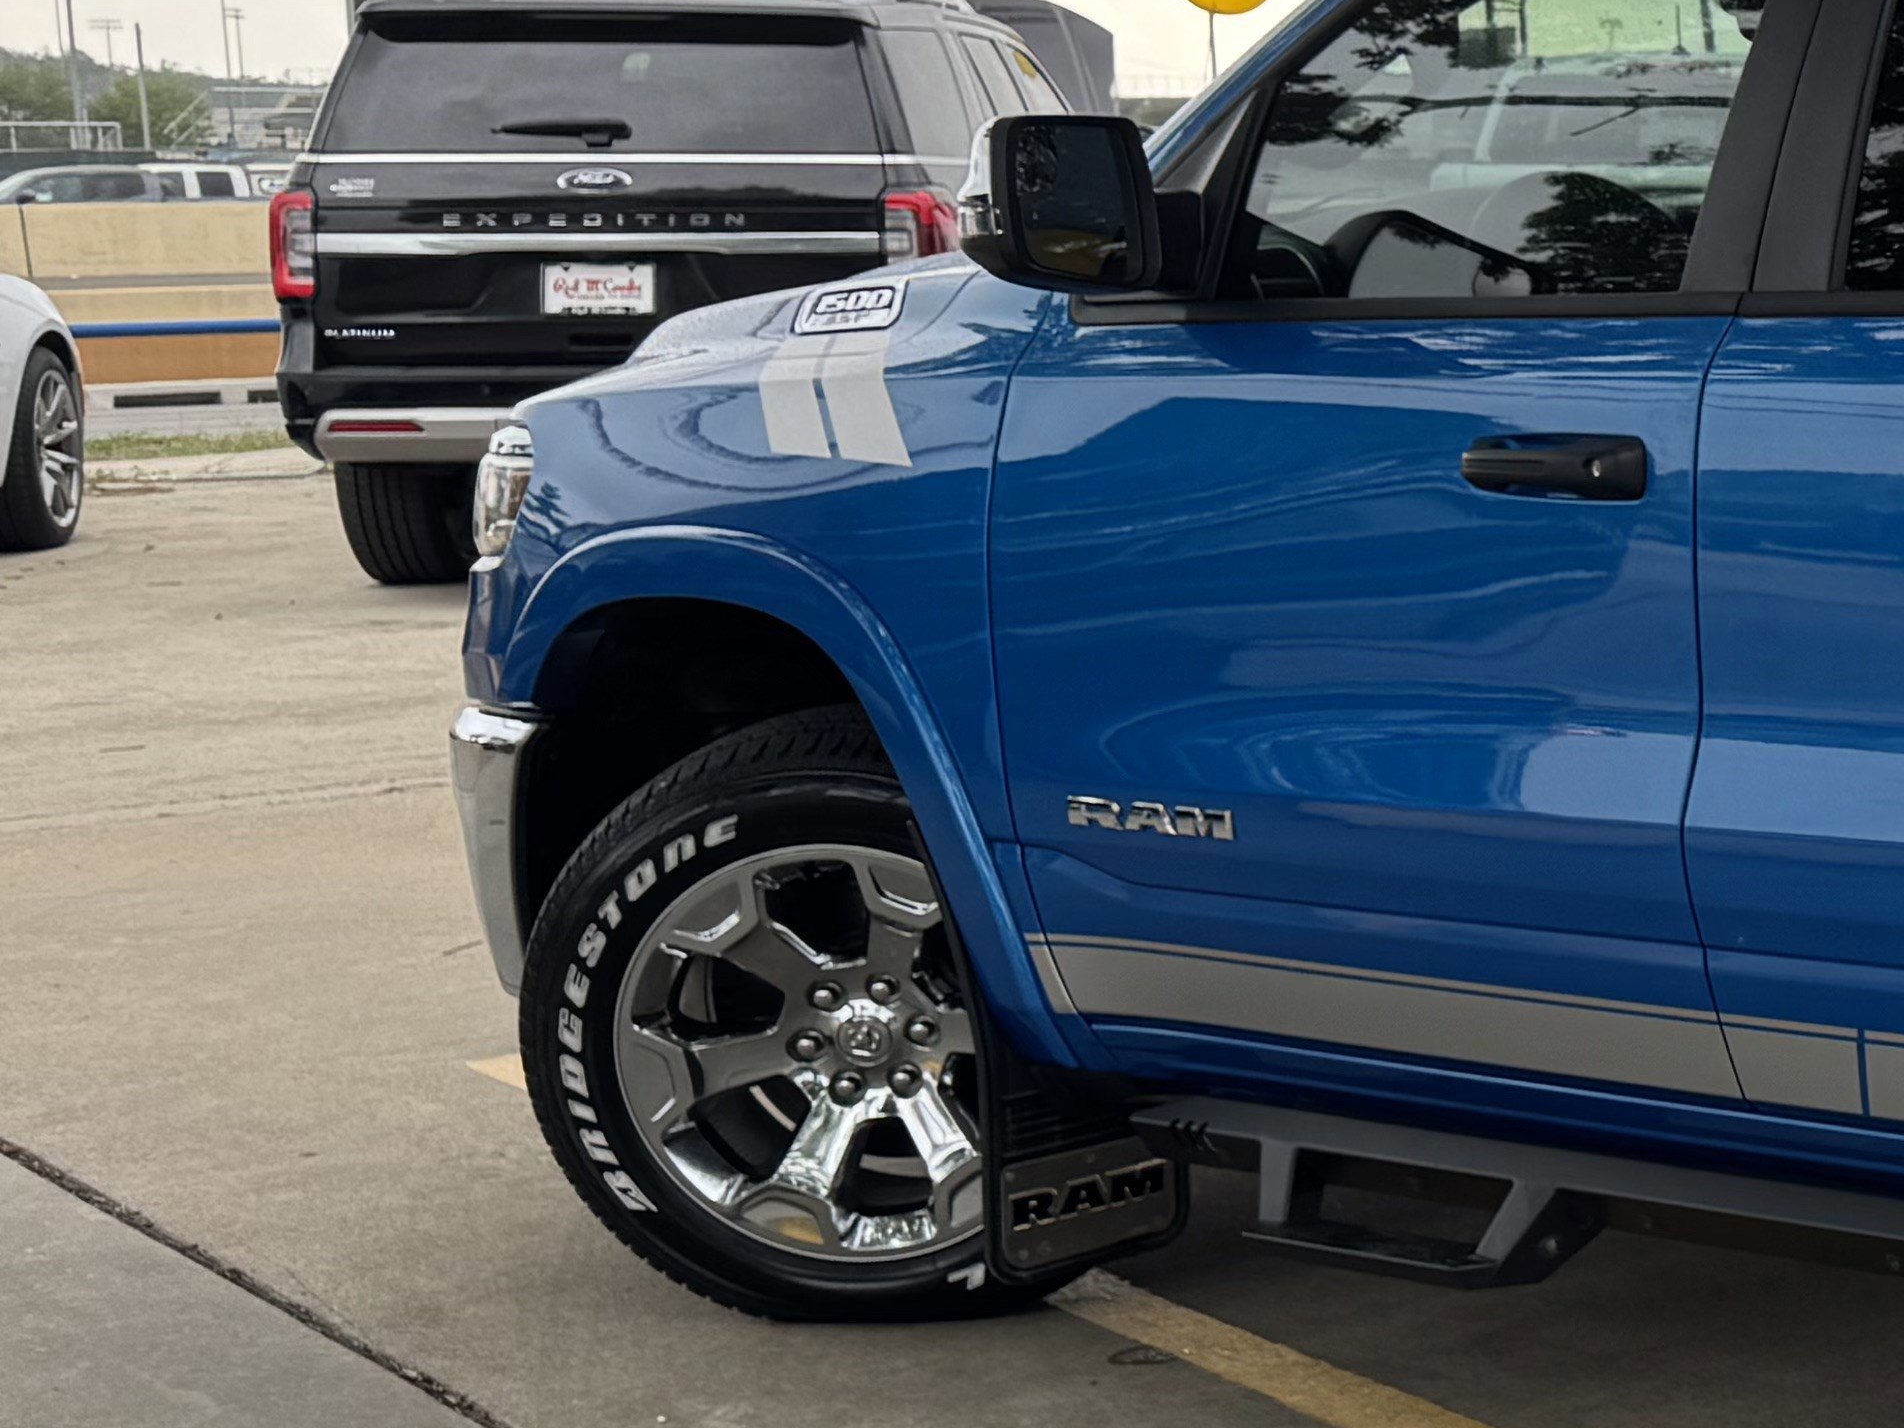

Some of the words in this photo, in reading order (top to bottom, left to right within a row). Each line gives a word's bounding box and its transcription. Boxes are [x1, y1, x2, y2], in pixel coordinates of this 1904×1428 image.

[442, 213, 746, 227] EXPEDITION
[1066, 794, 1235, 841] RAM
[557, 813, 739, 1213] BRIDGESTONE
[1008, 1158, 1169, 1232] RAM
